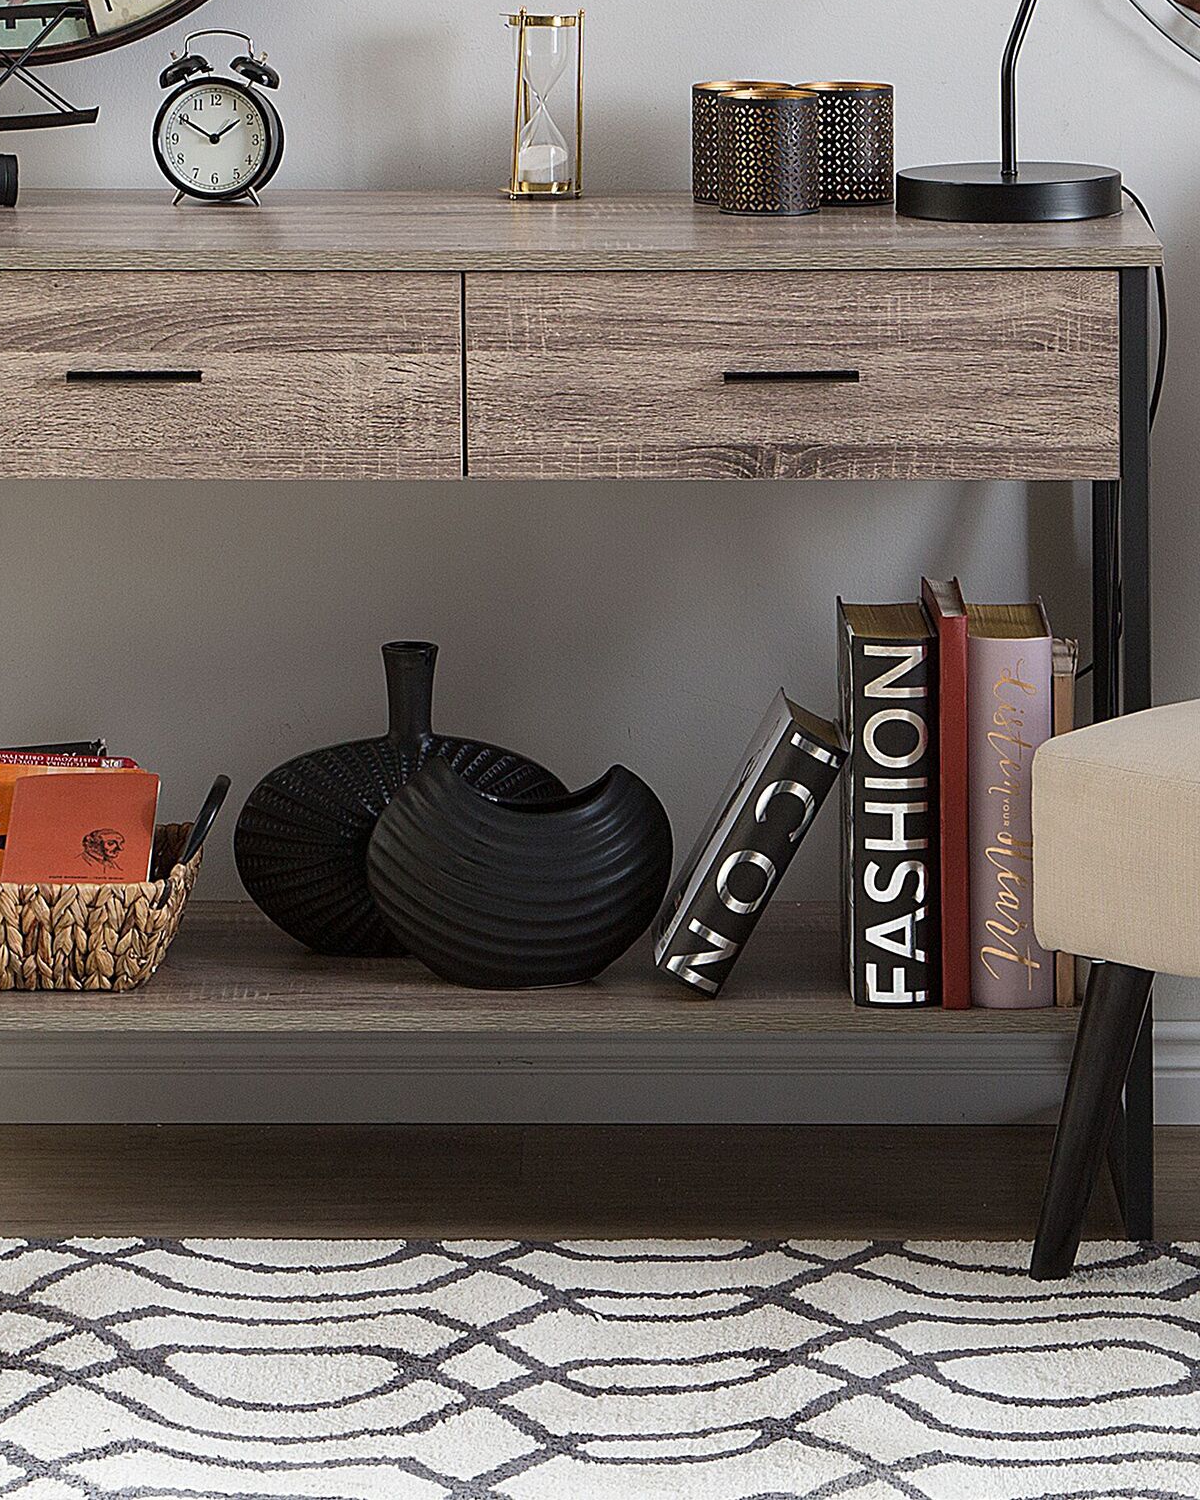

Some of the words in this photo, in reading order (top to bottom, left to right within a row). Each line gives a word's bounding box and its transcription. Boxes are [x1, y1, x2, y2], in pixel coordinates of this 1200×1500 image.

[193, 99, 203, 111] 11
[210, 94, 222, 106] 12
[233, 99, 237, 111] 1
[246, 113, 254, 125] 2
[171, 133, 179, 145] 9
[252, 134, 259, 146] 3
[177, 152, 185, 165] 8
[245, 154, 253, 166] 4
[192, 167, 200, 180] 7
[211, 172, 218, 184] 6
[233, 168, 240, 180] 5
[1002, 798, 1011, 827] YOUR
[864, 645, 929, 1004] FASHION
[666, 731, 841, 994] ICON
